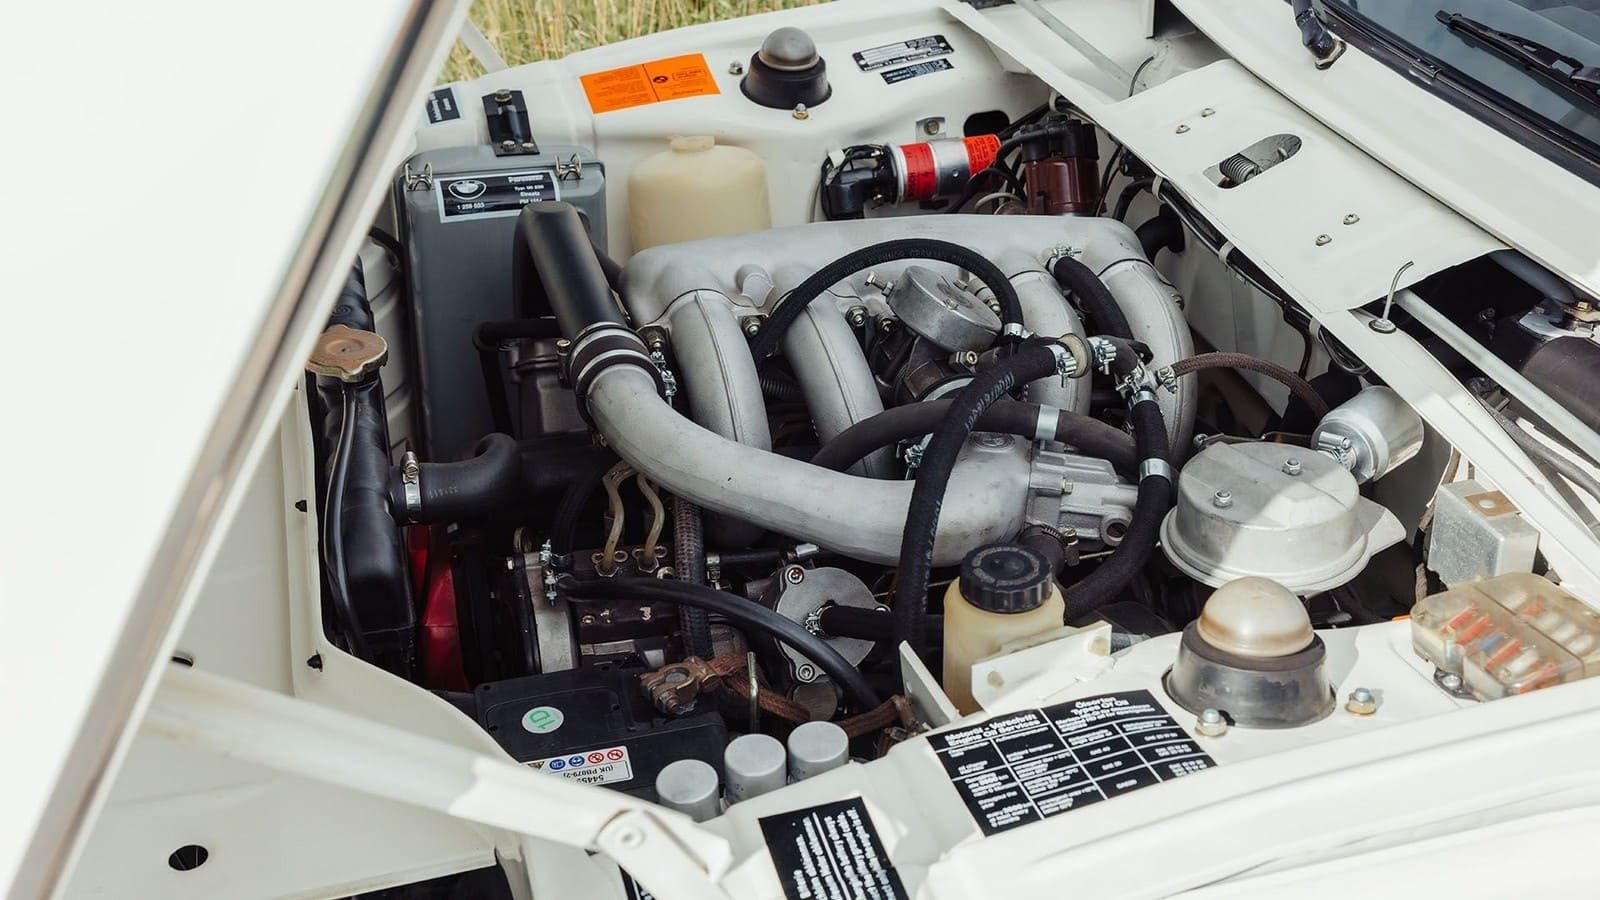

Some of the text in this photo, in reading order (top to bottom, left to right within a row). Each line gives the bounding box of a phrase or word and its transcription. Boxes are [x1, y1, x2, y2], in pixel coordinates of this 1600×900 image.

[1071, 705, 1101, 717] Types
[989, 714, 1038, 730] Vorschrift
[948, 734, 983, 747] Engine
[983, 729, 999, 738] Oil
